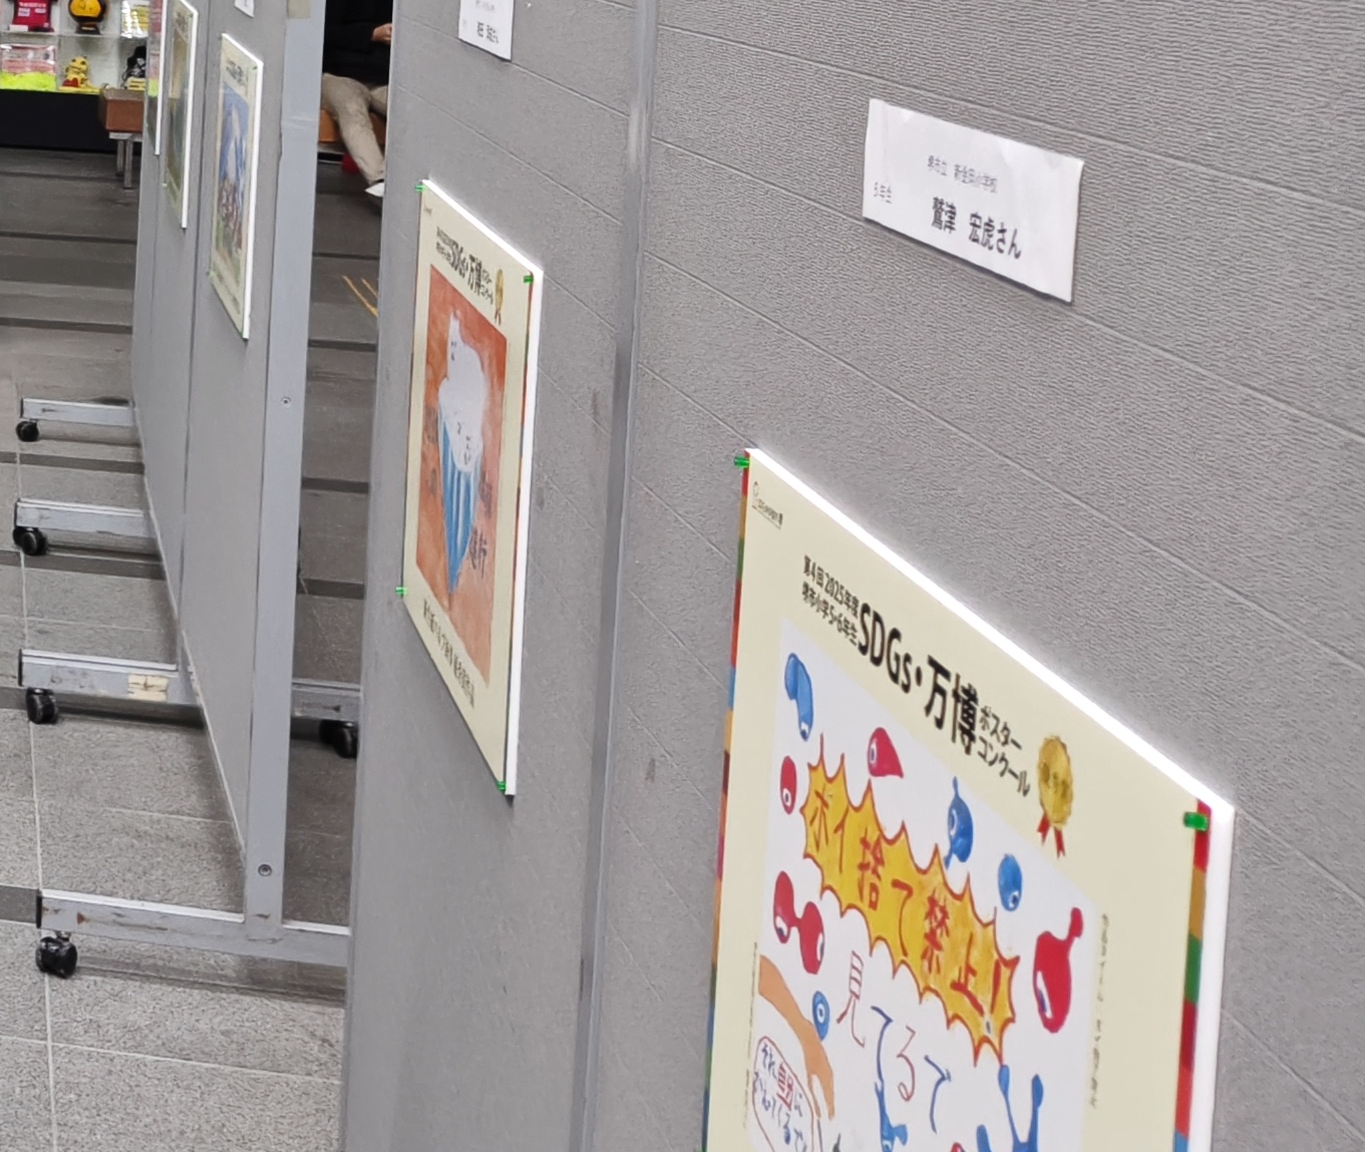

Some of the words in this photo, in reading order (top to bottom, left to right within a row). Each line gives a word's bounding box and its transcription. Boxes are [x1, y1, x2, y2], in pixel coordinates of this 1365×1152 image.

[857, 602, 979, 756] SDGs・万博
[979, 704, 1023, 750] ポスター
[976, 735, 1031, 798] コンクール
